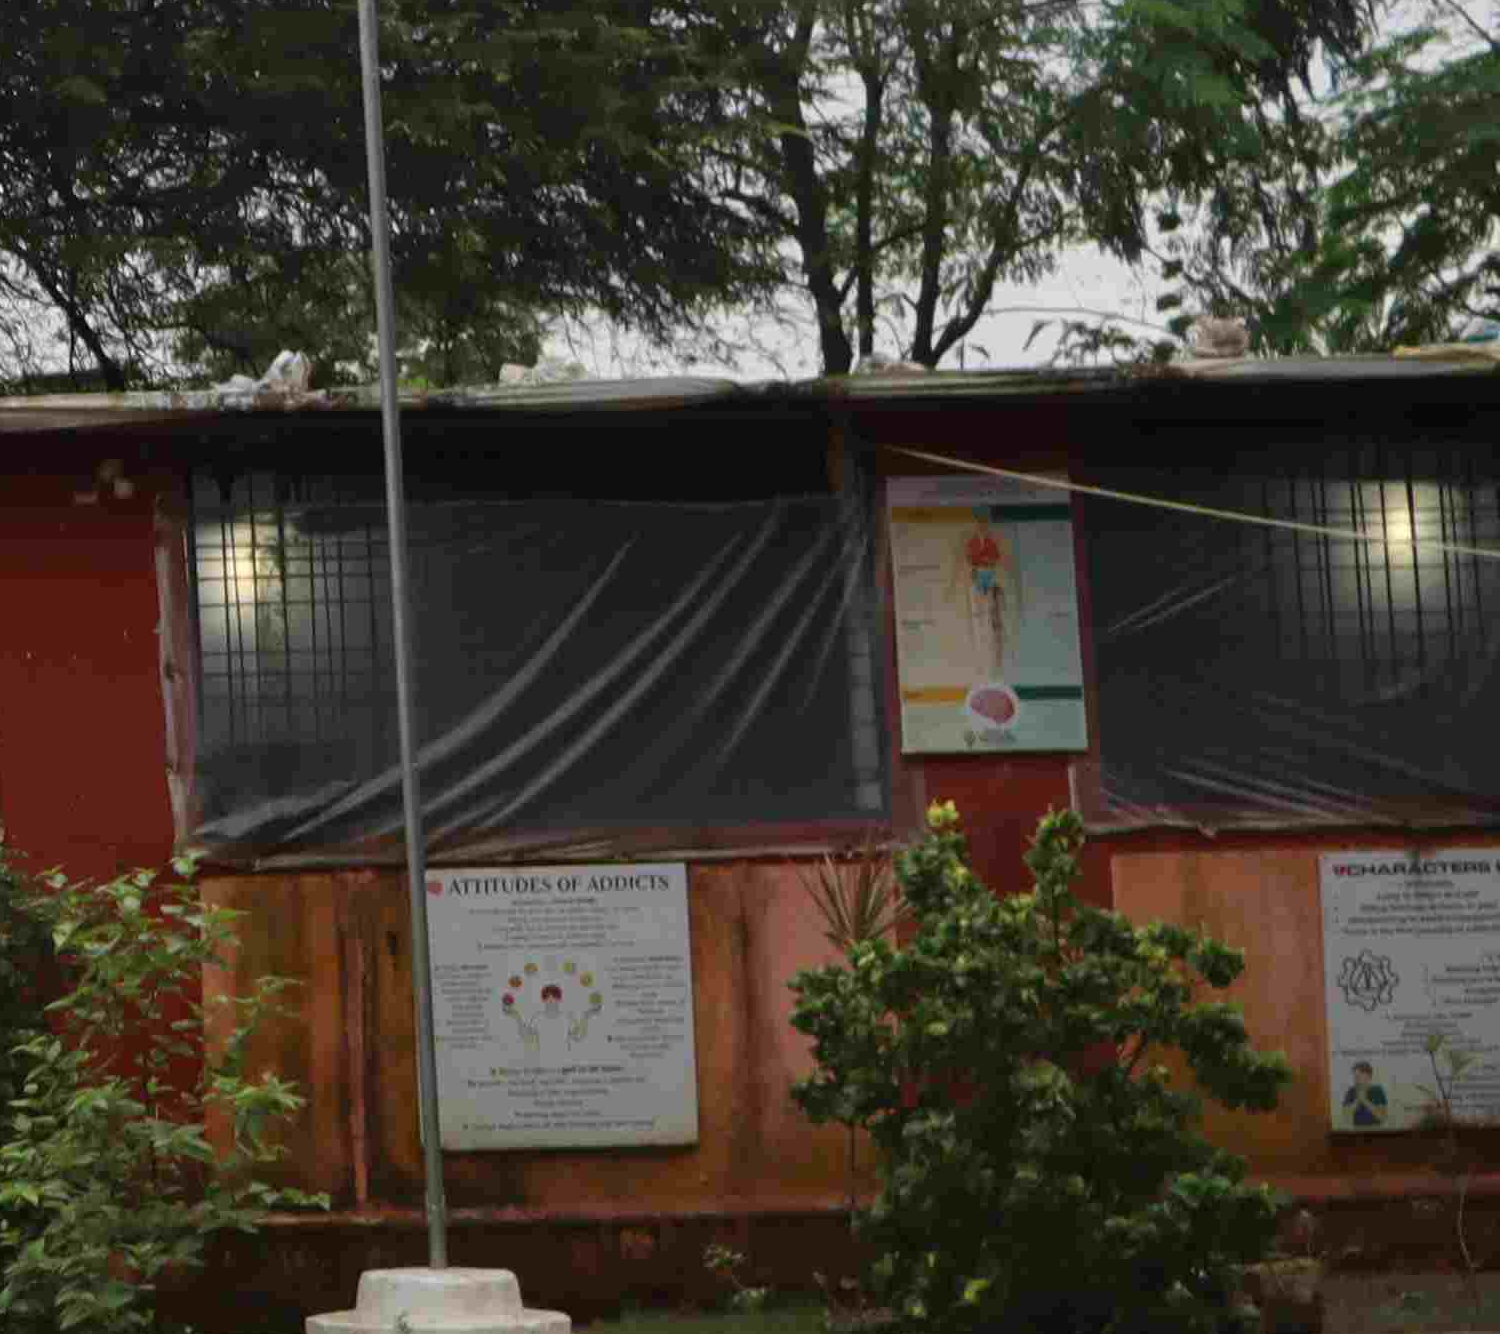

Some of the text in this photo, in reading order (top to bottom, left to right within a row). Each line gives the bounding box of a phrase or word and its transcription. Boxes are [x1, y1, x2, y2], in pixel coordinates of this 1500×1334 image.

[449, 875, 669, 896] ATTITUDES OF ADDICTS
